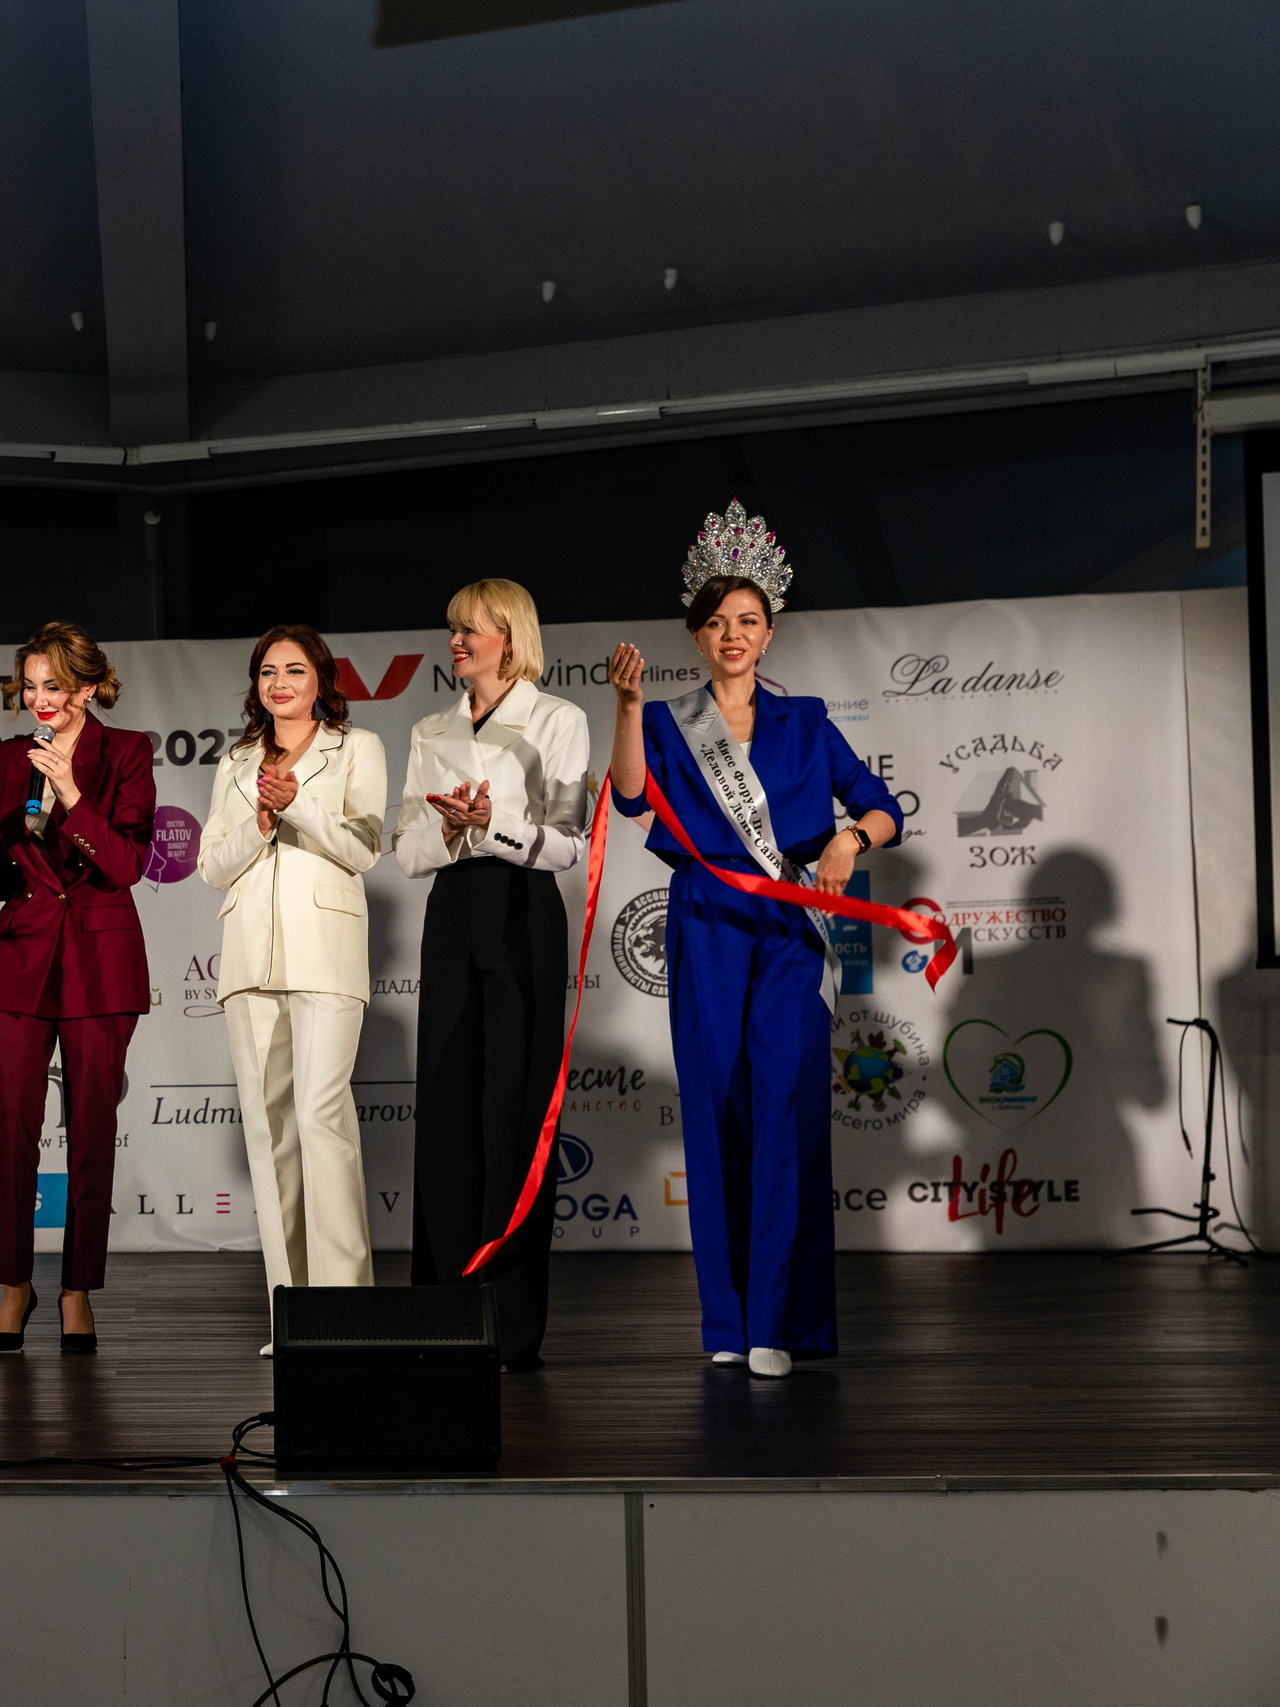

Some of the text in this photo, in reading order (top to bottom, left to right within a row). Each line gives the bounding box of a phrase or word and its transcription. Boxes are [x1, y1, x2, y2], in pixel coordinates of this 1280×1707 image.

[961, 661, 1065, 694] danse
[826, 699, 869, 711] ение
[140, 728, 246, 766] 202
[714, 738, 736, 769] Мисс
[939, 734, 1064, 774] УСАДЬБА
[730, 802, 753, 837] День
[156, 829, 192, 842] FILATOV
[969, 845, 1037, 869] ЗОЖ
[185, 989, 201, 1000] BY
[907, 1180, 1080, 1204] CITY STYLE
